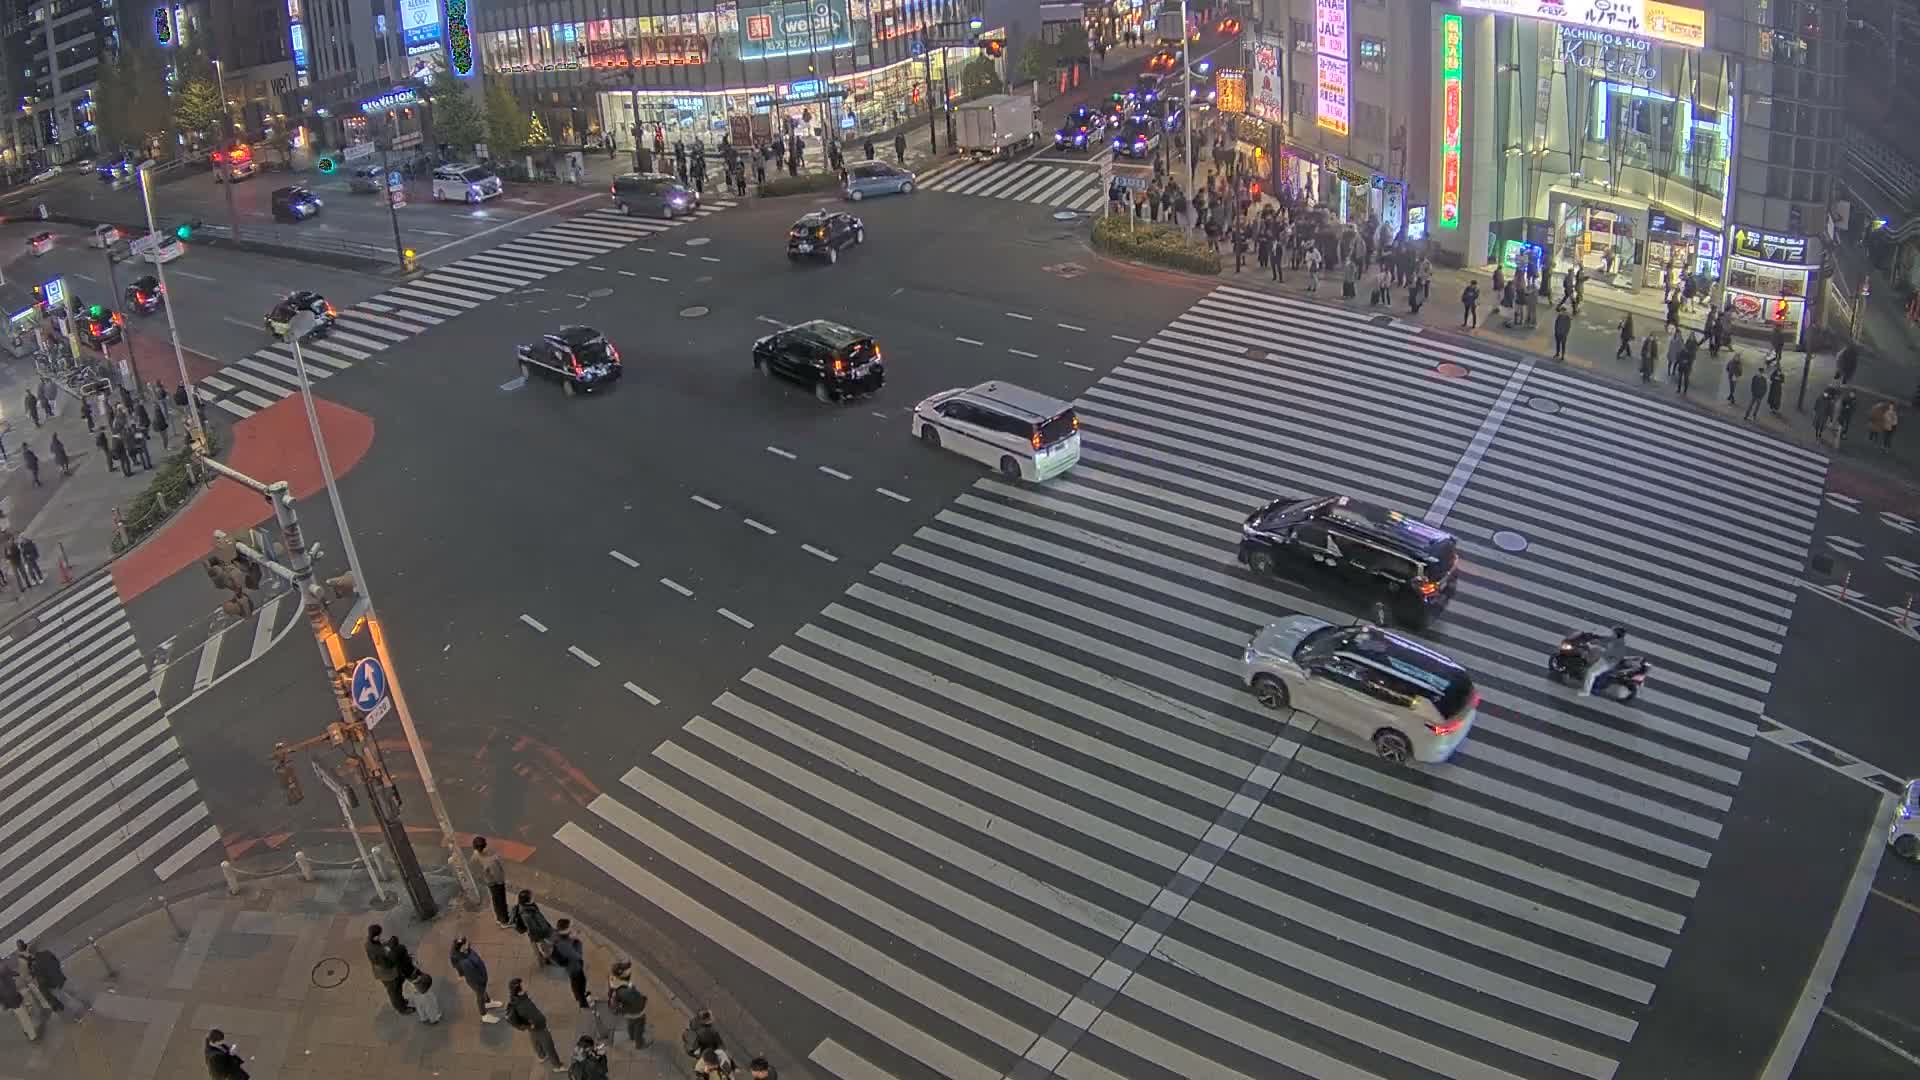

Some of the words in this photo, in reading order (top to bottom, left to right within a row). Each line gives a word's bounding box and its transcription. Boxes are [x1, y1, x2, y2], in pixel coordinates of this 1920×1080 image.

[1318, 21, 1338, 37] JAL
[1585, 9, 1640, 29] ルノアール
[1558, 24, 1613, 45] PACHINKO
[1615, 36, 1622, 46] &
[1626, 38, 1651, 51] SLOT
[1564, 39, 1657, 80] Kaleido
